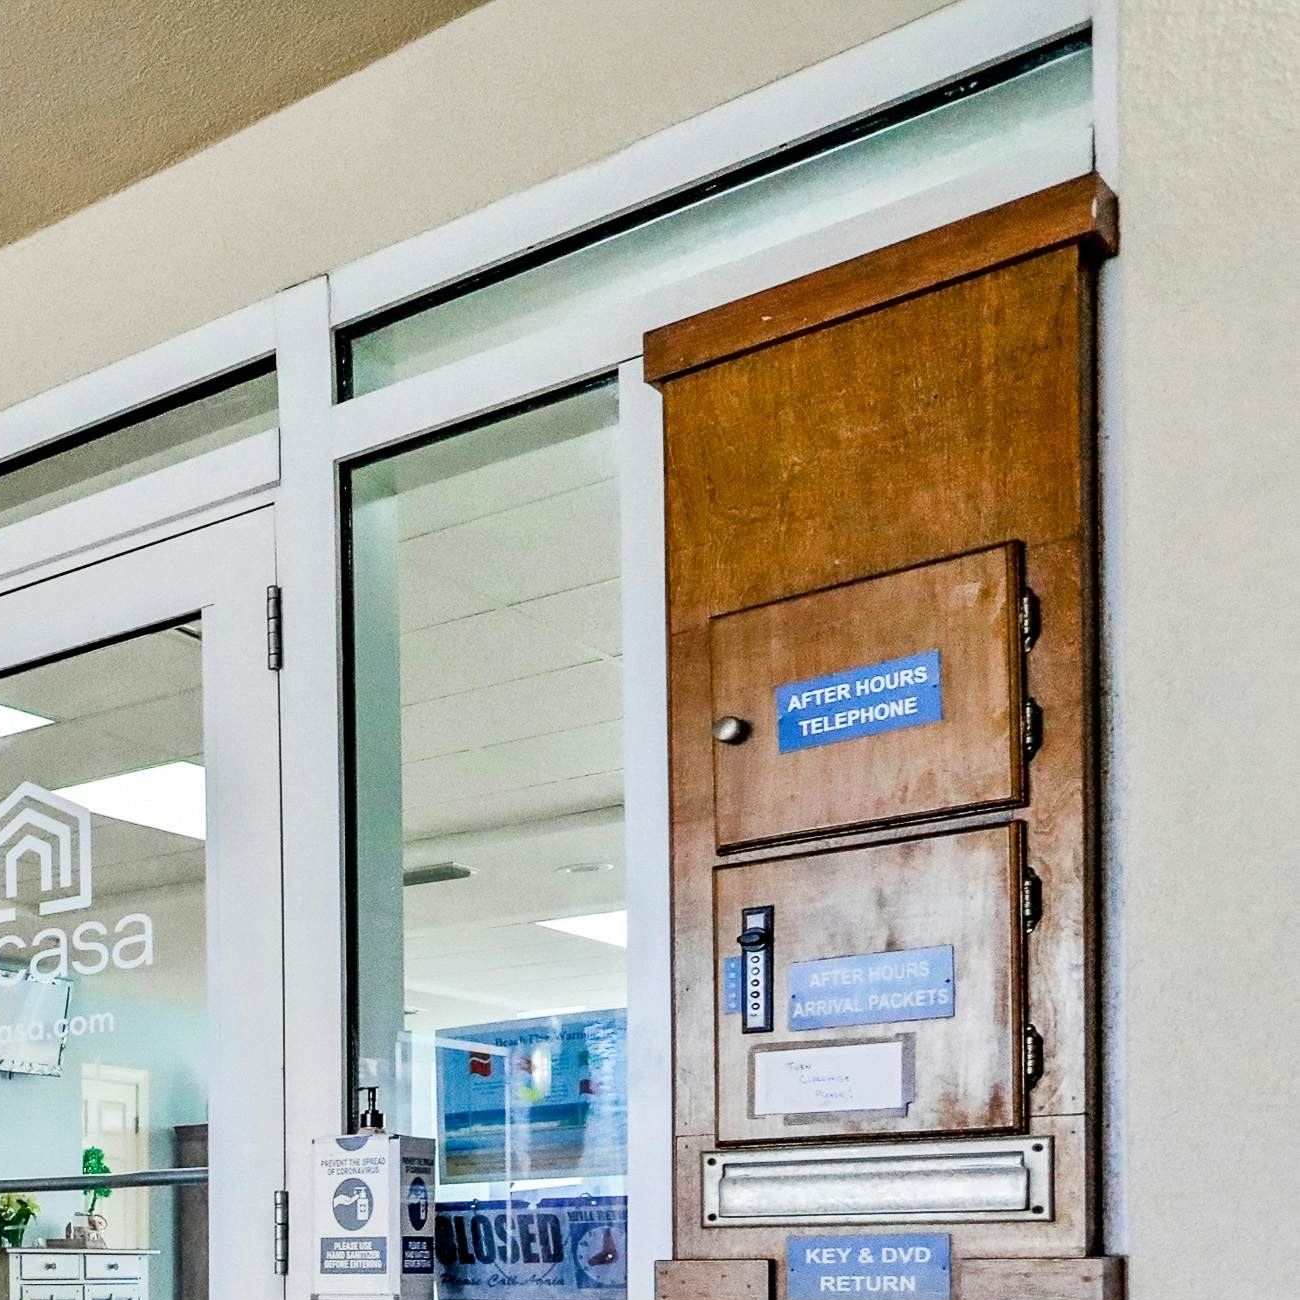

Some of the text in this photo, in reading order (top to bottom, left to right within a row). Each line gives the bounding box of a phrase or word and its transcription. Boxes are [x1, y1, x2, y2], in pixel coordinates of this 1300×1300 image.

[787, 666, 928, 712] AFTER HOURS
[799, 696, 918, 736] TELEPHONE
[809, 961, 931, 989] AFTER HOURS
[793, 988, 949, 1019] ARRIVAL PACKETS
[805, 1247, 932, 1265] KEY & DVD
[819, 1275, 917, 1293] RETURN
